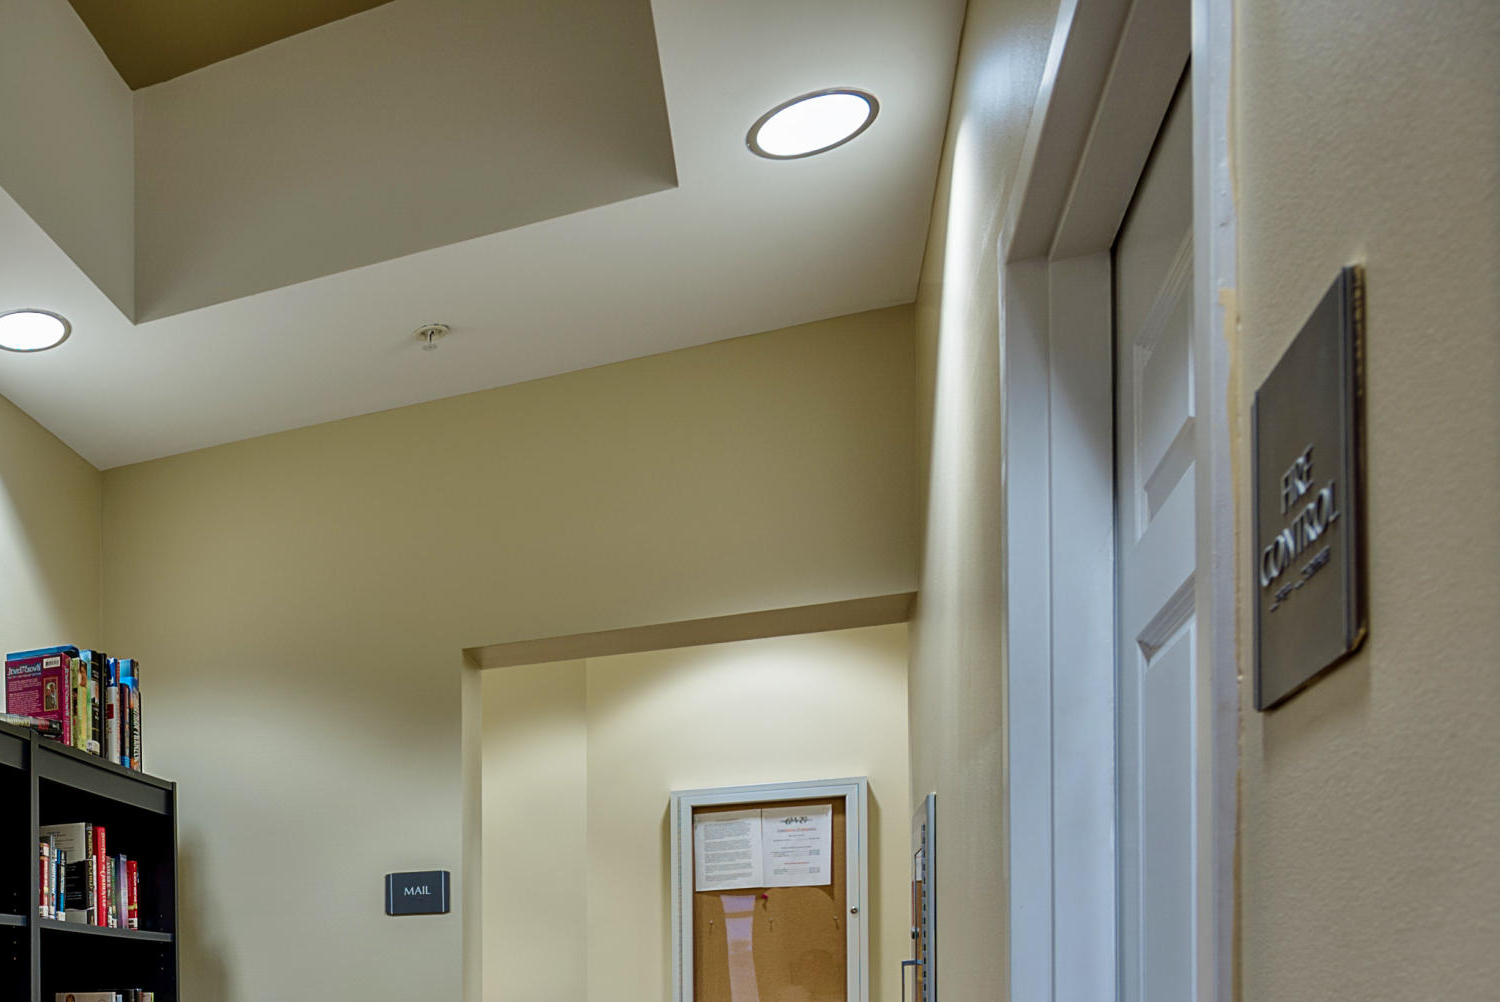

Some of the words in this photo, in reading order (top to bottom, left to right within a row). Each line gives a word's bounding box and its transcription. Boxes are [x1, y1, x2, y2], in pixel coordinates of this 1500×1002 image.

[1279, 443, 1315, 515] FIRE
[1260, 478, 1340, 588] CONTROL
[404, 886, 432, 896] MAIL
